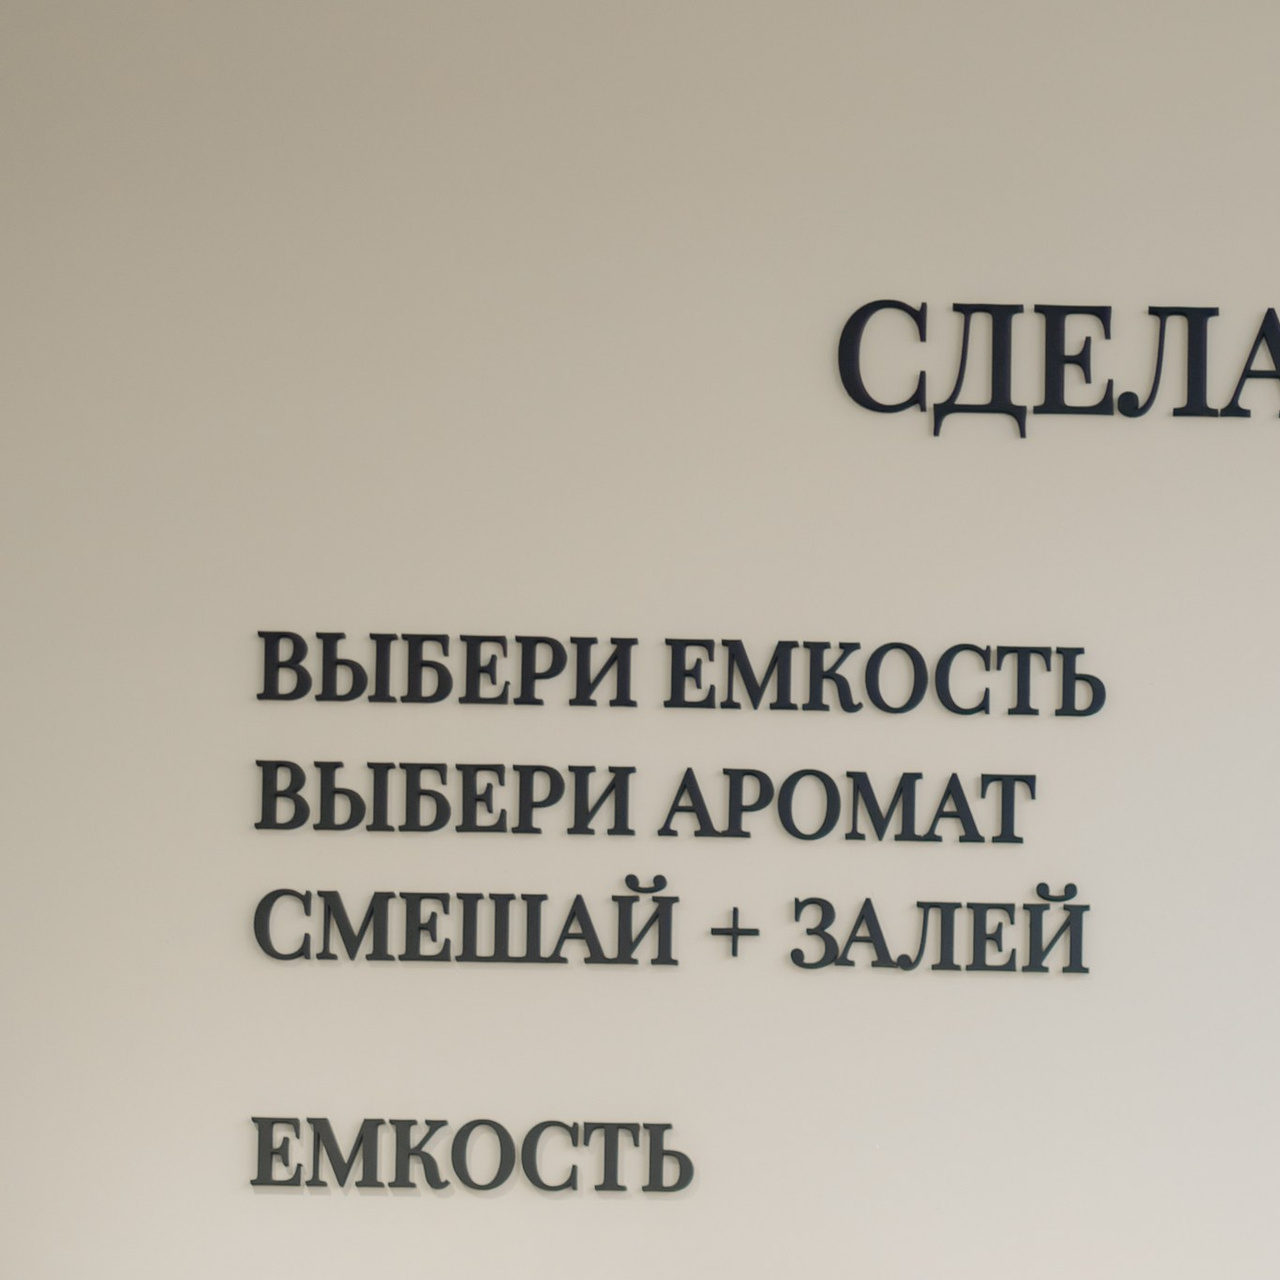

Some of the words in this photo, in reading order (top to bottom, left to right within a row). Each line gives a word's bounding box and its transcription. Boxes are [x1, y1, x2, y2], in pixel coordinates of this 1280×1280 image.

[257, 631, 638, 707] ВЫБЕРИ
[664, 639, 1107, 718] ЕМКОСТЬ
[255, 760, 636, 836] ВЫБЕРИ
[658, 768, 1036, 844] АРОМАТ
[252, 875, 679, 966] СМЕШАЙ
[791, 883, 1090, 975] ЗАЛЕЙ
[250, 1117, 694, 1194] ЕМКОСТЬ
